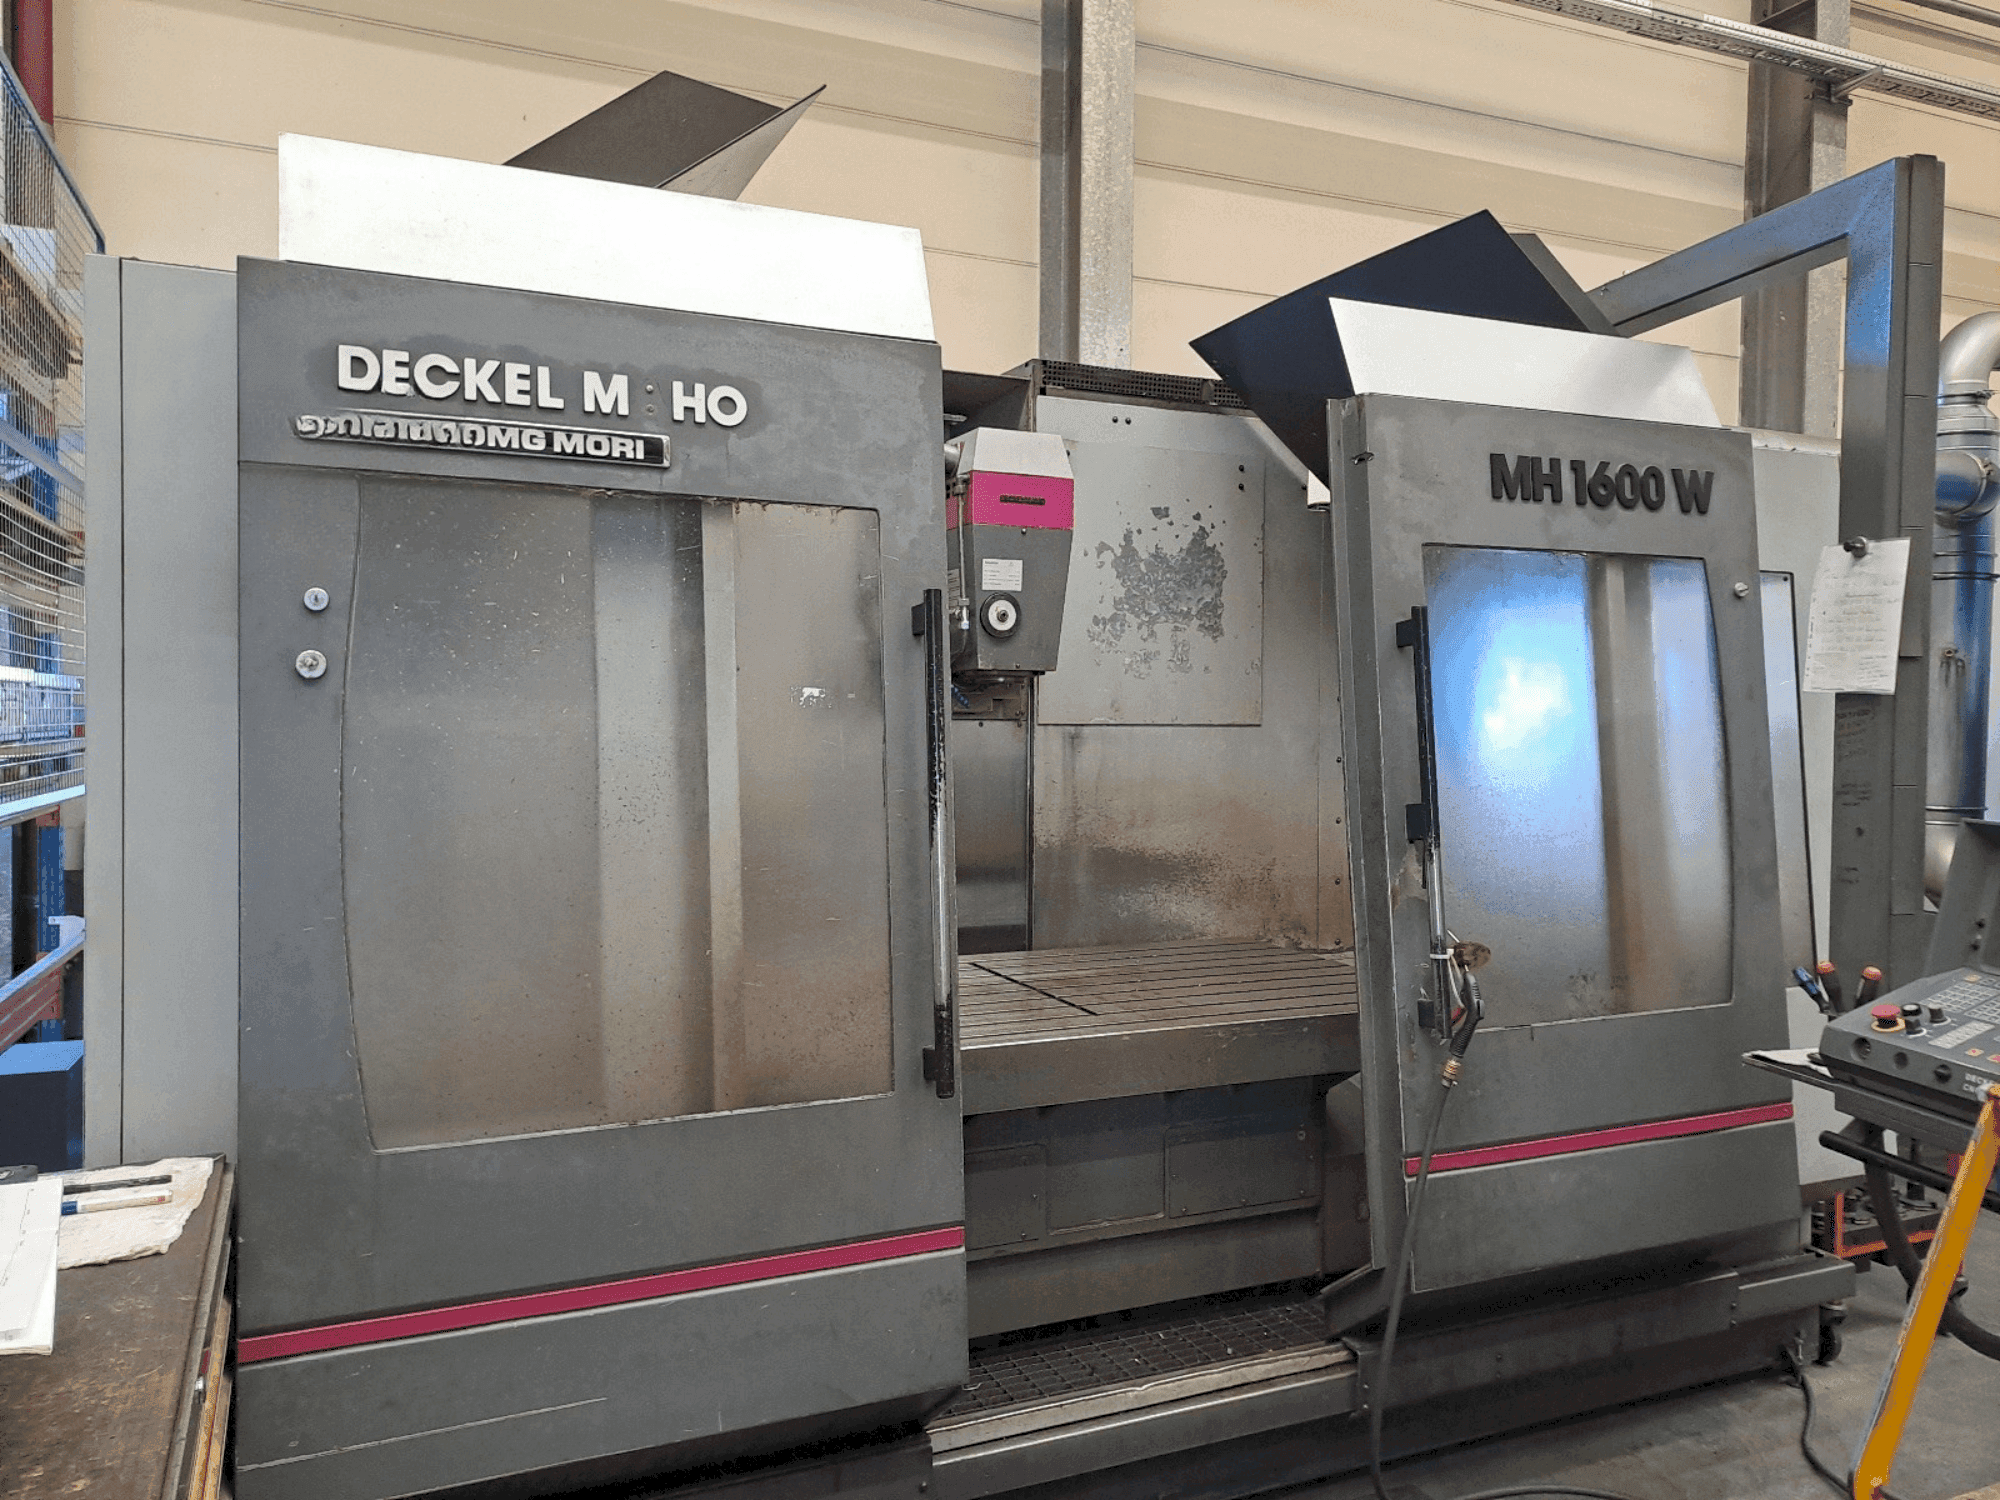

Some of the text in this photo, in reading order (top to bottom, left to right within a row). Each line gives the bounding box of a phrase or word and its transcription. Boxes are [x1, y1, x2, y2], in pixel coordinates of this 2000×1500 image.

[336, 344, 566, 409] DECKEL
[553, 431, 646, 460] MORI
[1489, 453, 1715, 515] MH 1600 W
